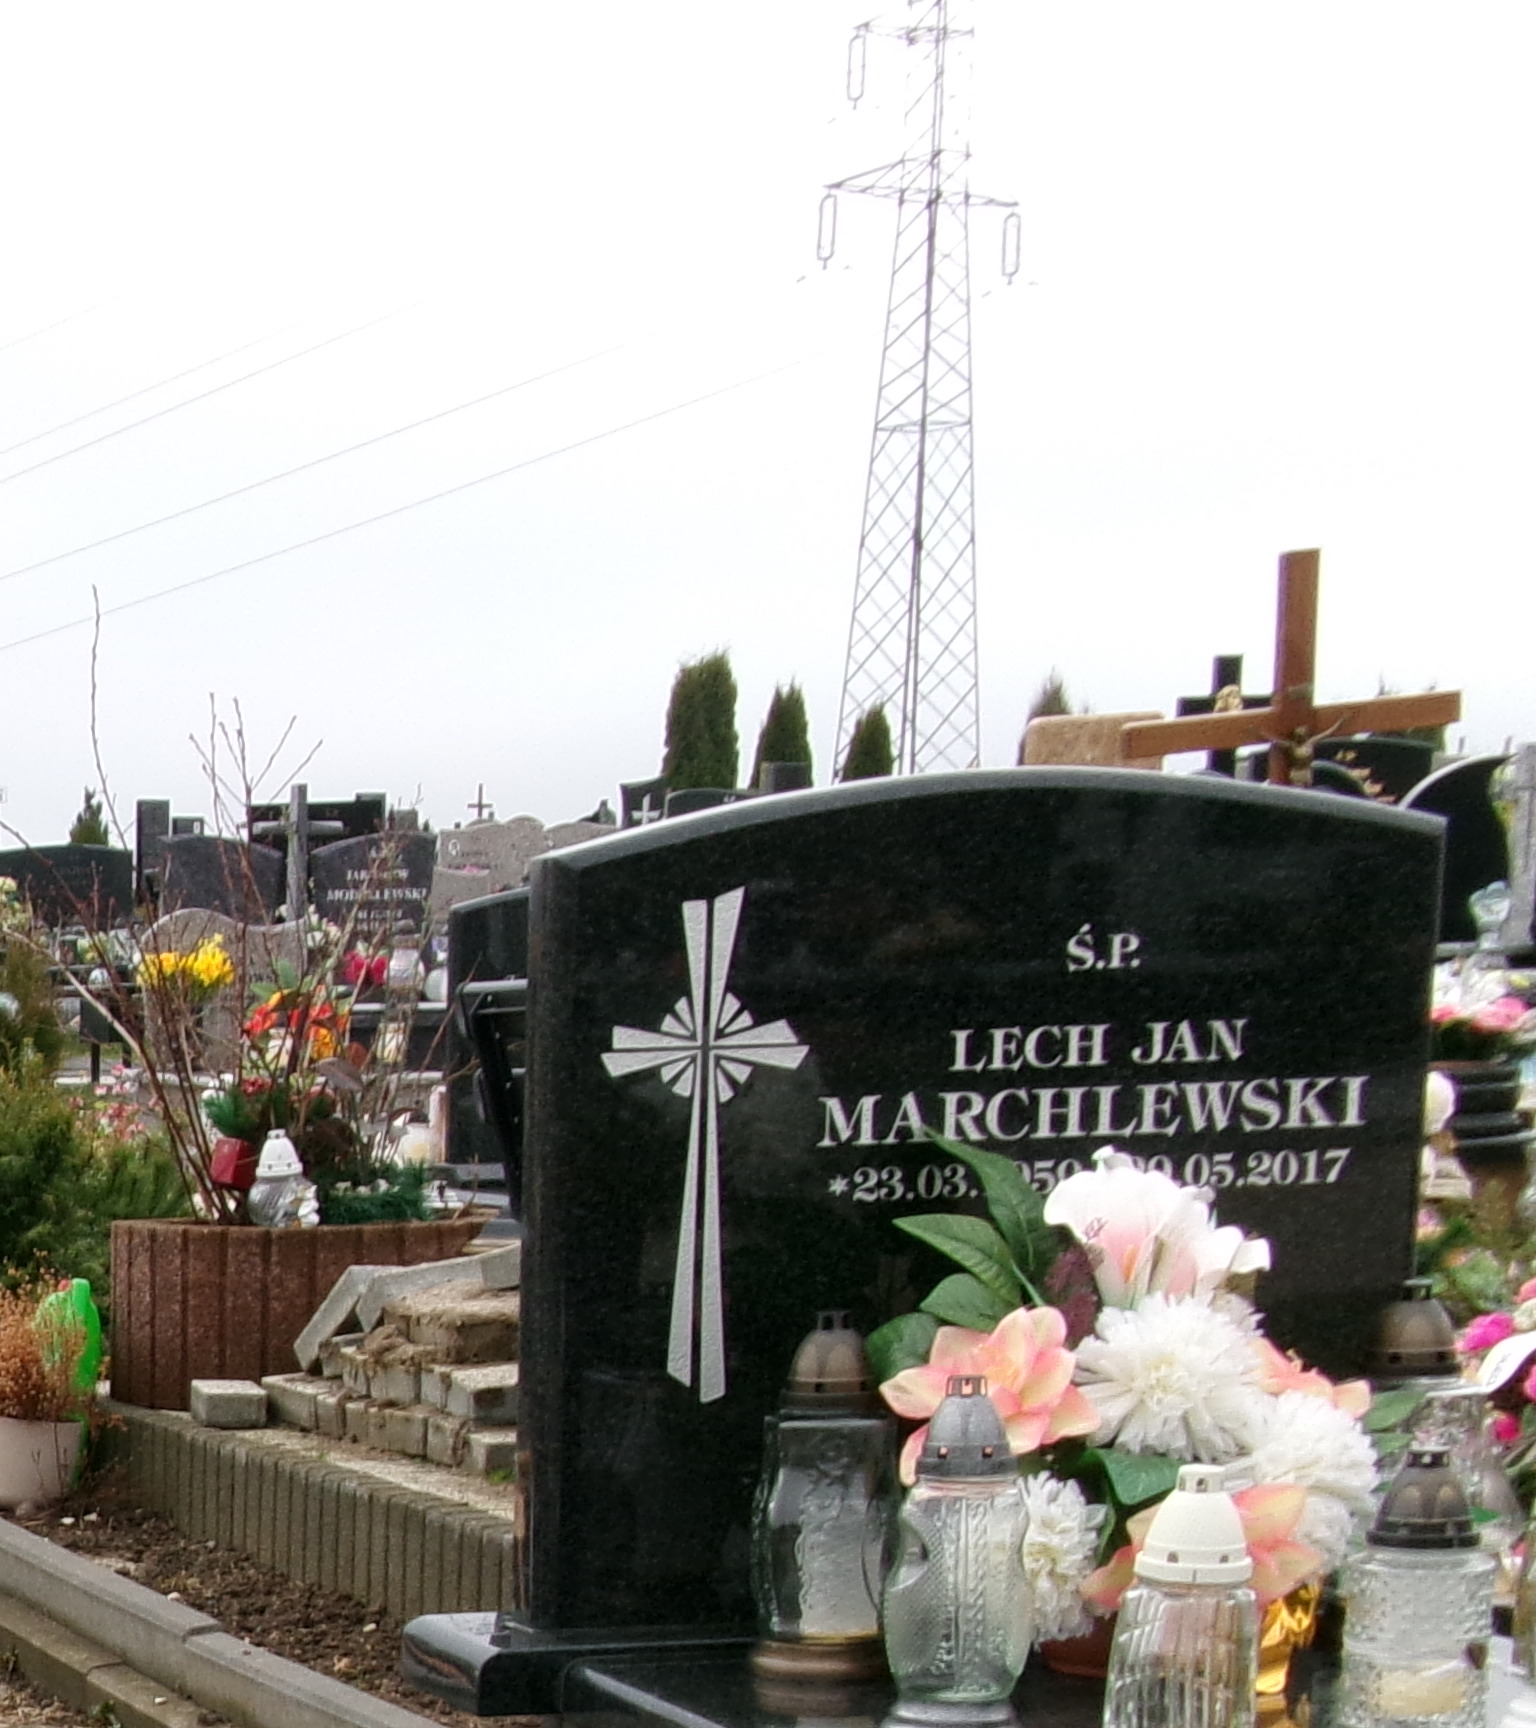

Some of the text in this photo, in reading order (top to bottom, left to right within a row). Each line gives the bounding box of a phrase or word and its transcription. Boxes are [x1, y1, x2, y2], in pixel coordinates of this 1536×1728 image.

[1066, 923, 1141, 973] Ś.P.
[948, 1018, 1249, 1073] LECH JAN
[816, 1075, 1371, 1148] MARCHLEWSKI
